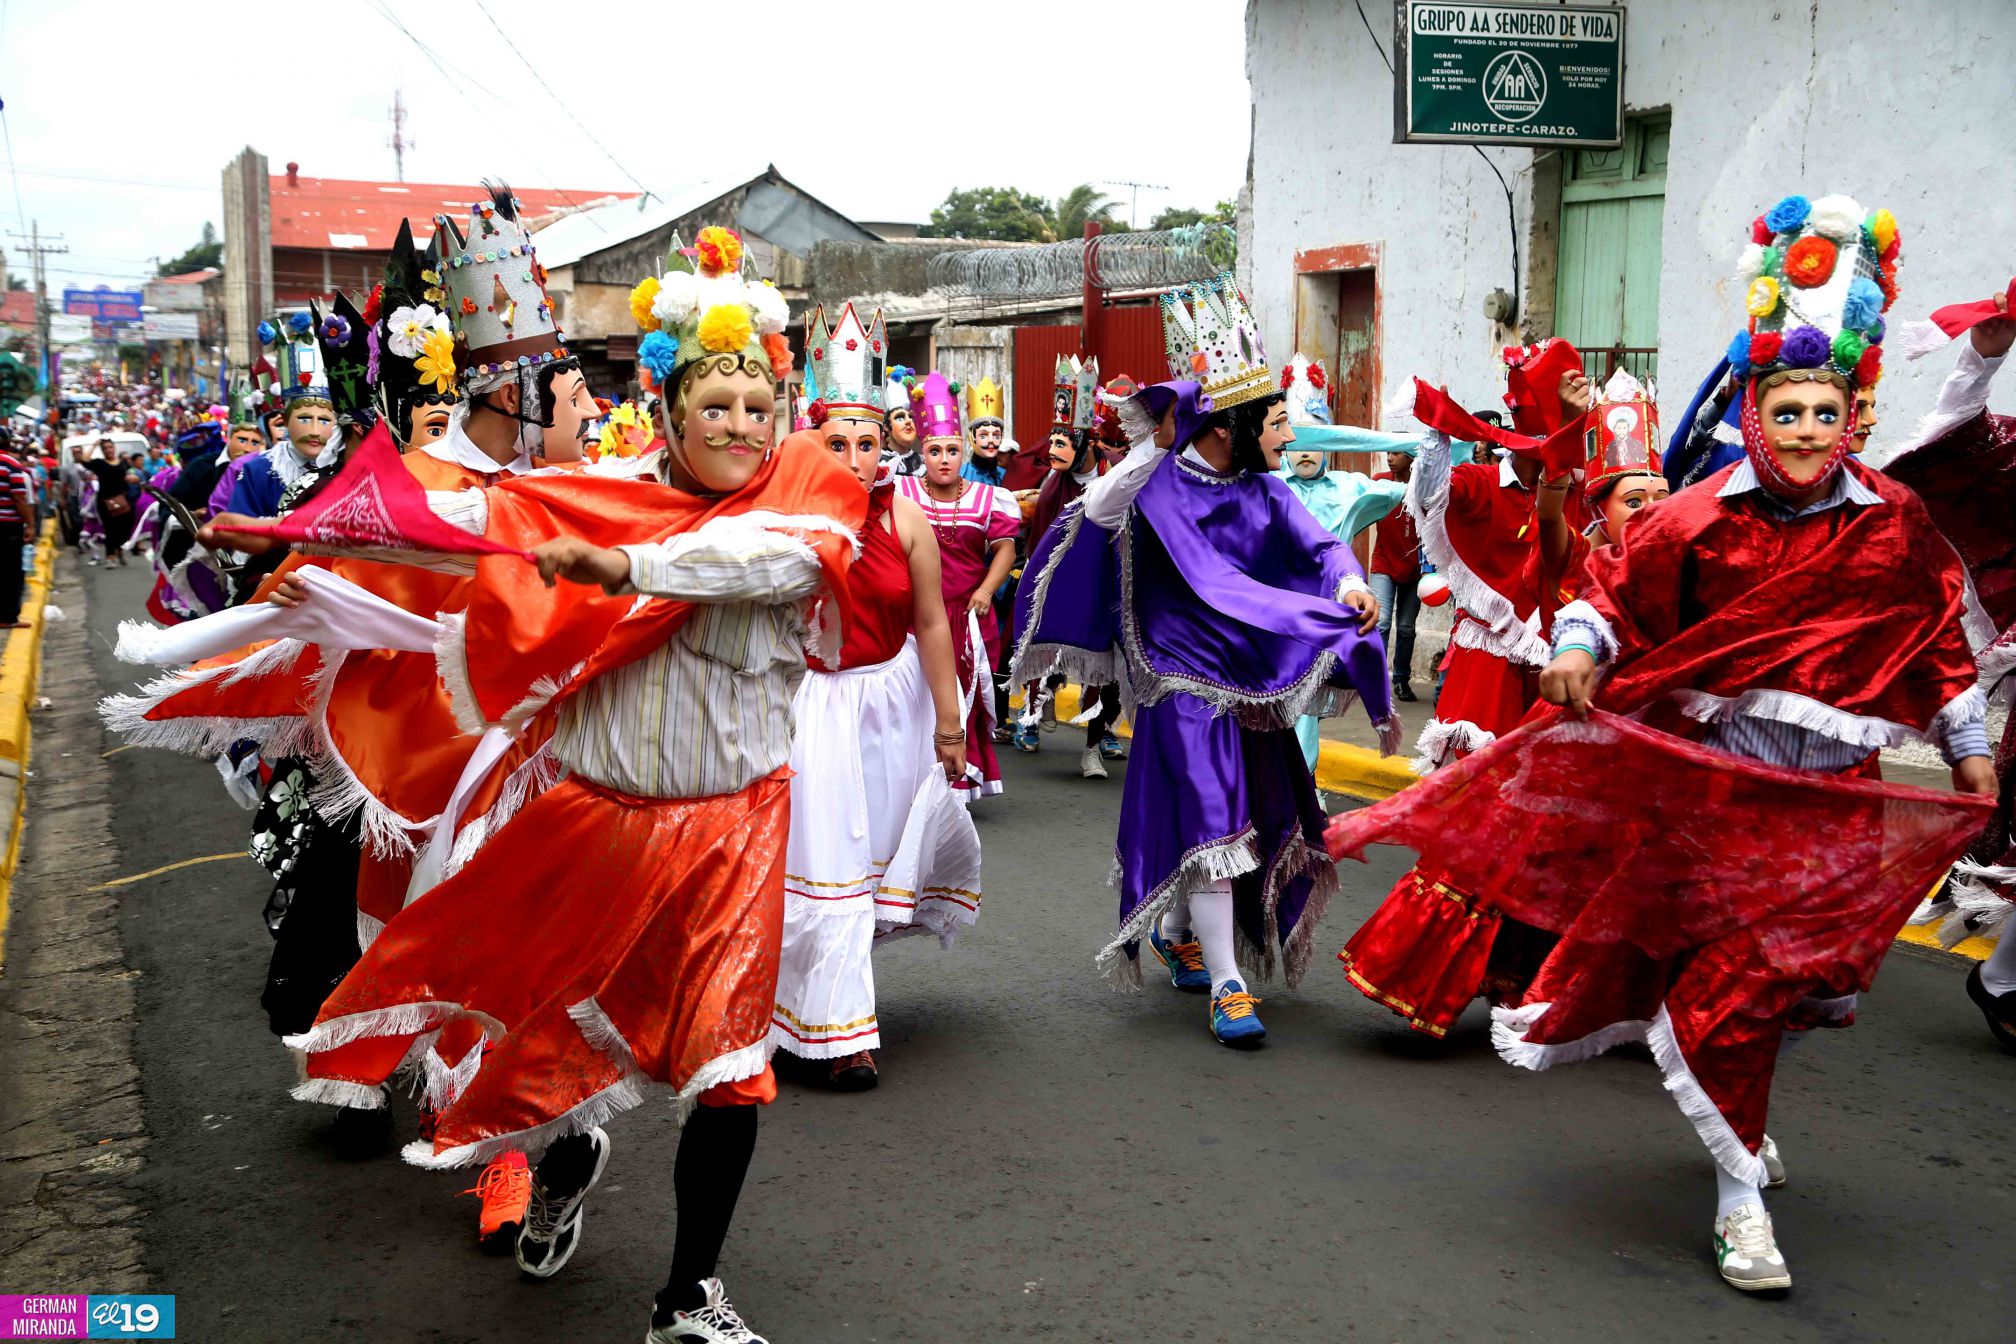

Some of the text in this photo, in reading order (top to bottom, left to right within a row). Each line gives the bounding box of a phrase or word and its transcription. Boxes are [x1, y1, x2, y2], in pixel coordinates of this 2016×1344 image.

[1418, 9, 1613, 38] GRUPO AA SENDERO DE VIDA
[1491, 64, 1507, 86] UNIDAD
[1524, 62, 1540, 89] SERVICIO
[1559, 65, 1611, 73] BIENVENIDOS!
[1504, 73, 1525, 98] AA
[1449, 121, 1578, 136] JINOTEPE-CARAZO.
